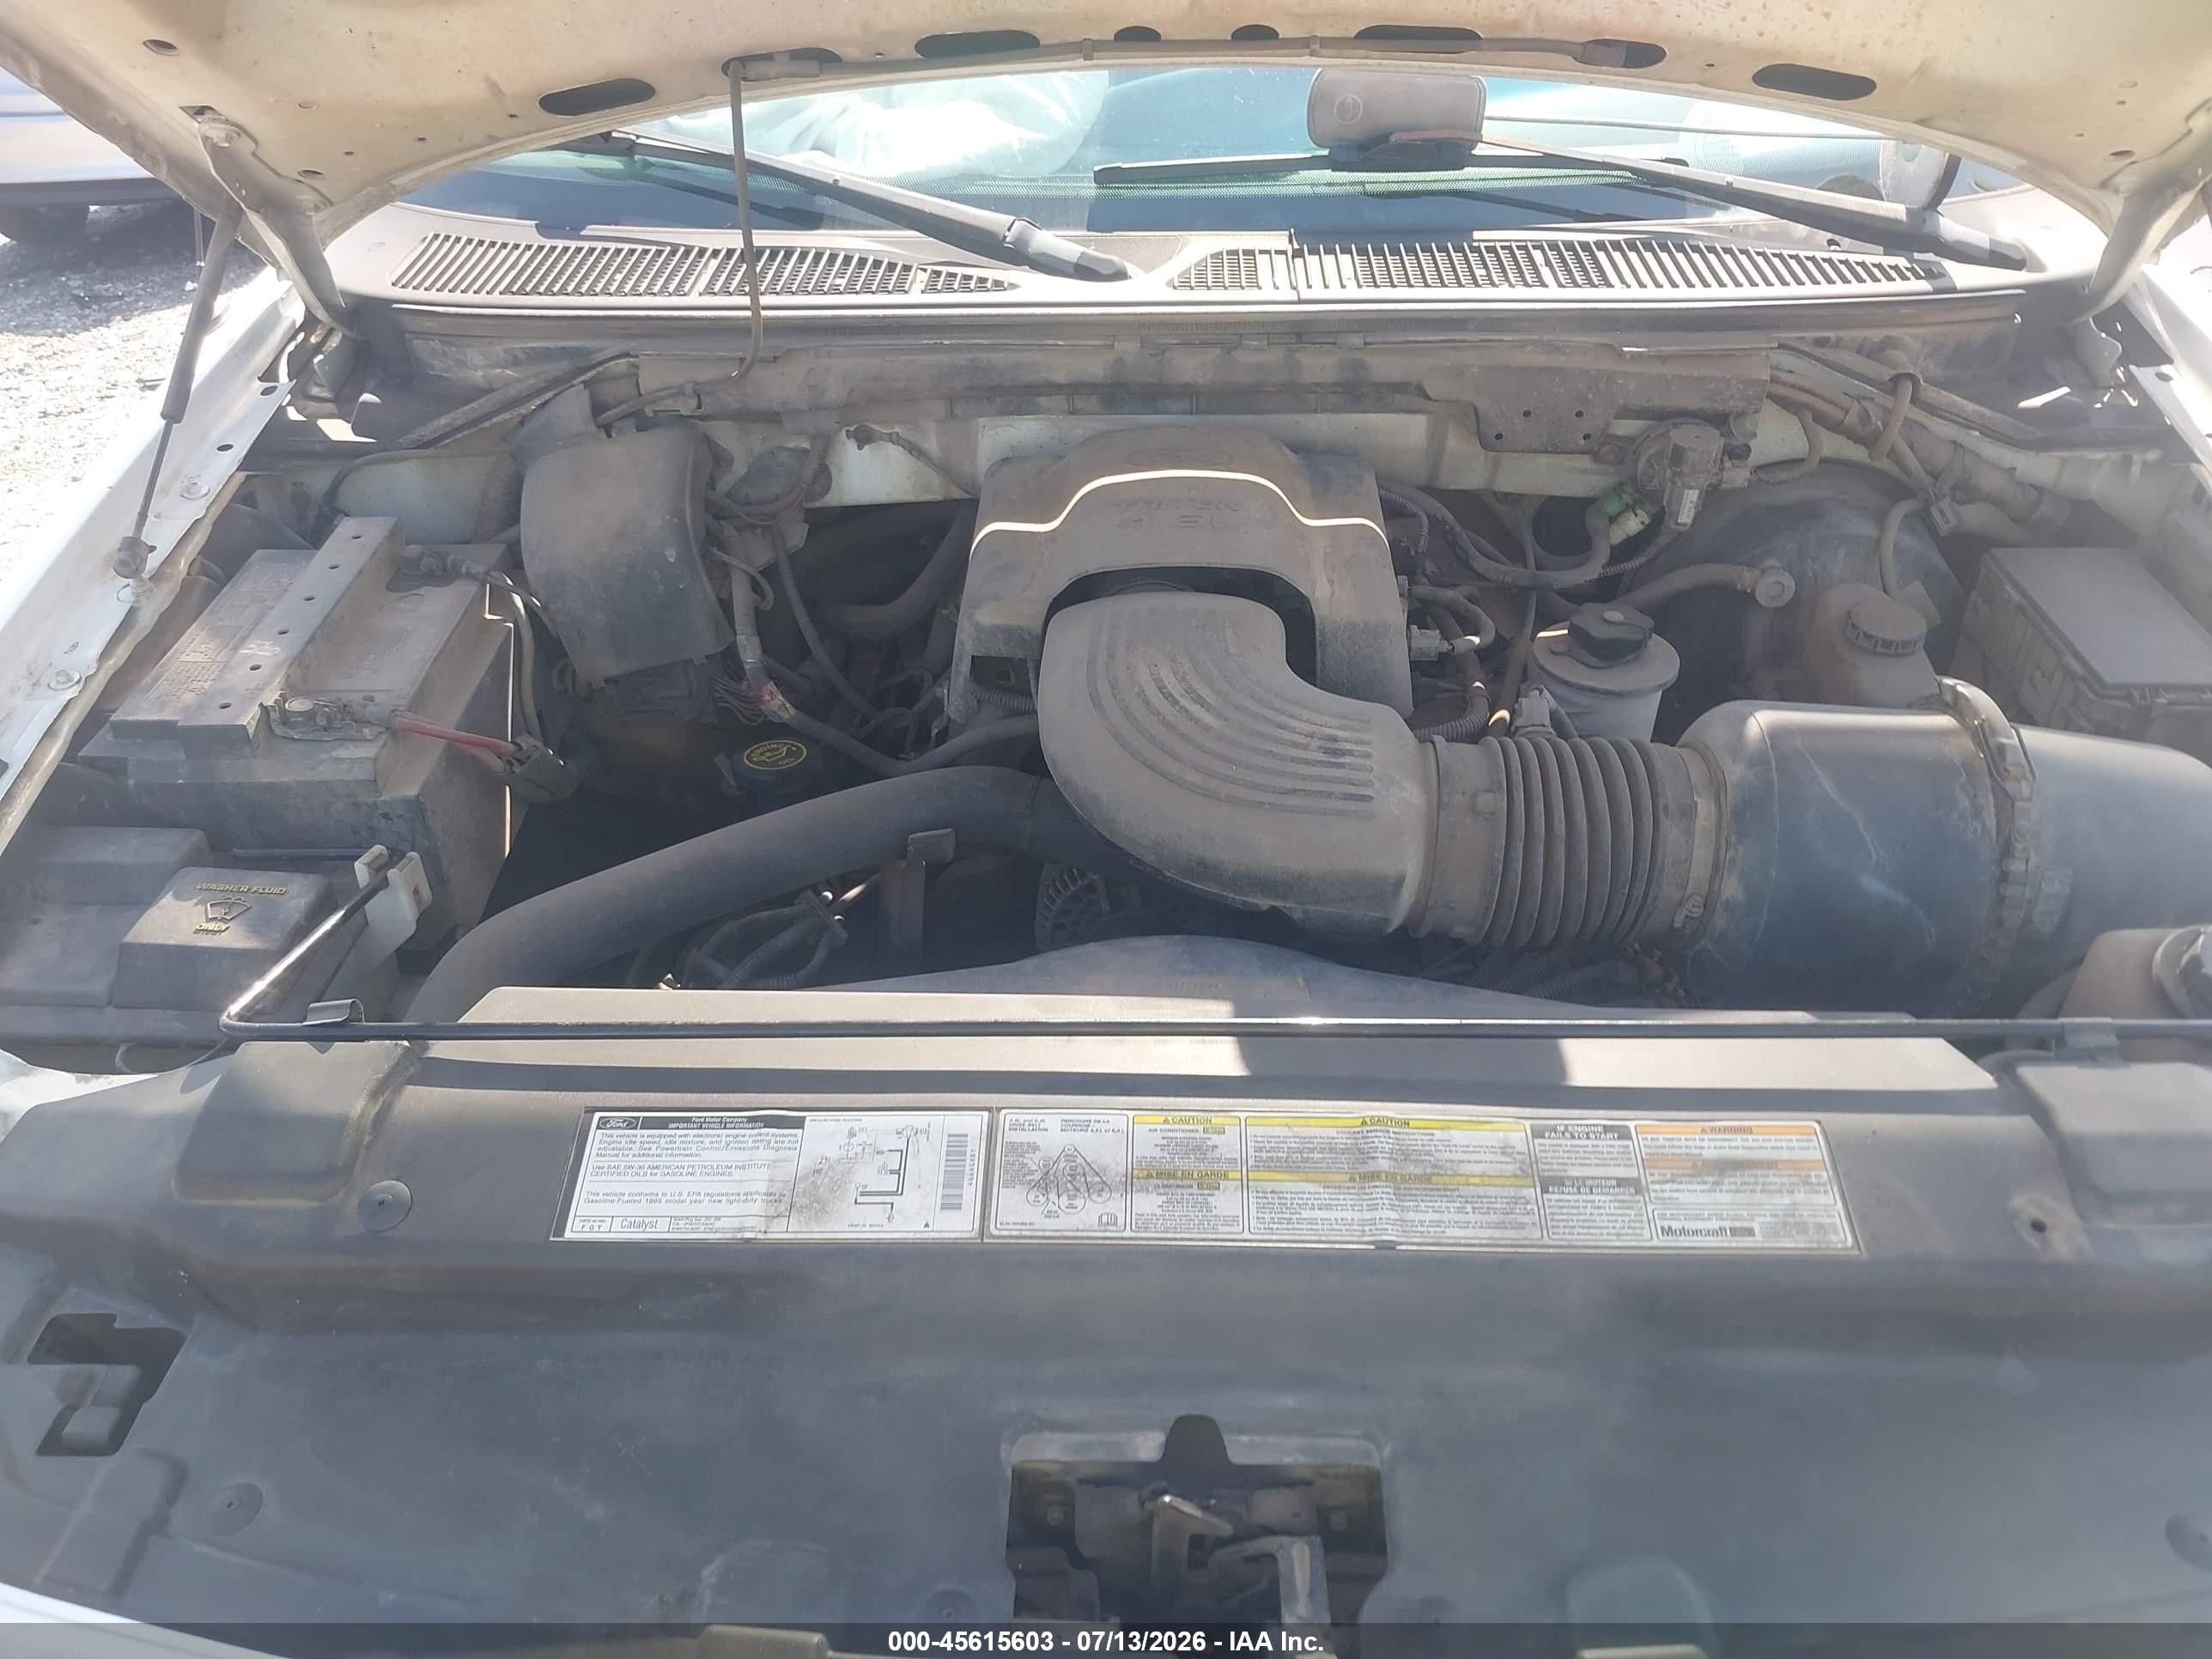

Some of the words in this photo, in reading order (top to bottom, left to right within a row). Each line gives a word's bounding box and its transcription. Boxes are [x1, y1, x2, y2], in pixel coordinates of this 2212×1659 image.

[196, 883, 249, 893] WASHER
[196, 922, 230, 933] ONLY
[606, 1119, 629, 1127] Ford
[1369, 1117, 1410, 1127] CAUTION
[621, 1218, 659, 1233] Catalyst
[1660, 1225, 1728, 1237] Motorcraft
